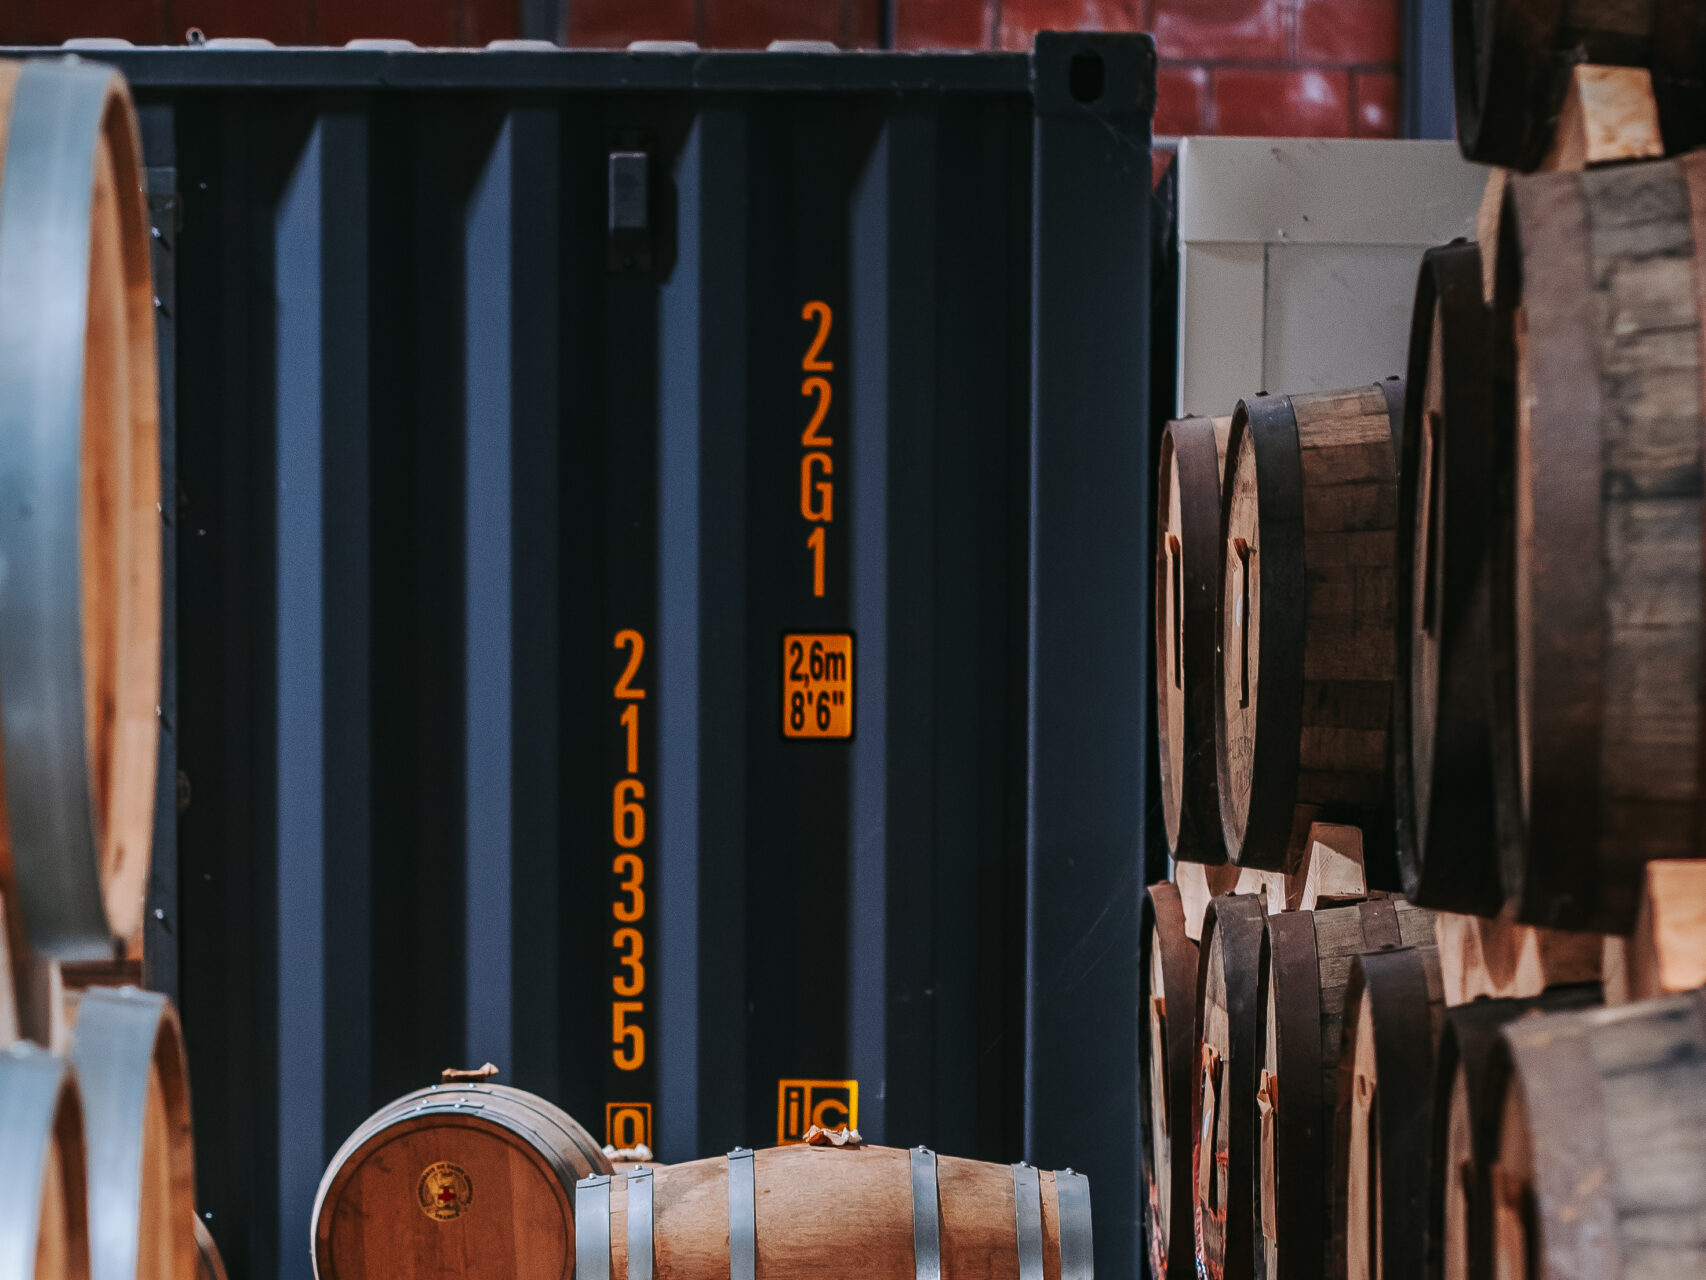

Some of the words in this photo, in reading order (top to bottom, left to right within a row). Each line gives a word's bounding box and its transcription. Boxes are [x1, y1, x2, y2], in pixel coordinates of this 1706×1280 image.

[801, 301, 834, 597] 22G1
[790, 641, 847, 688] 2,6m
[613, 630, 646, 1071] 216335
